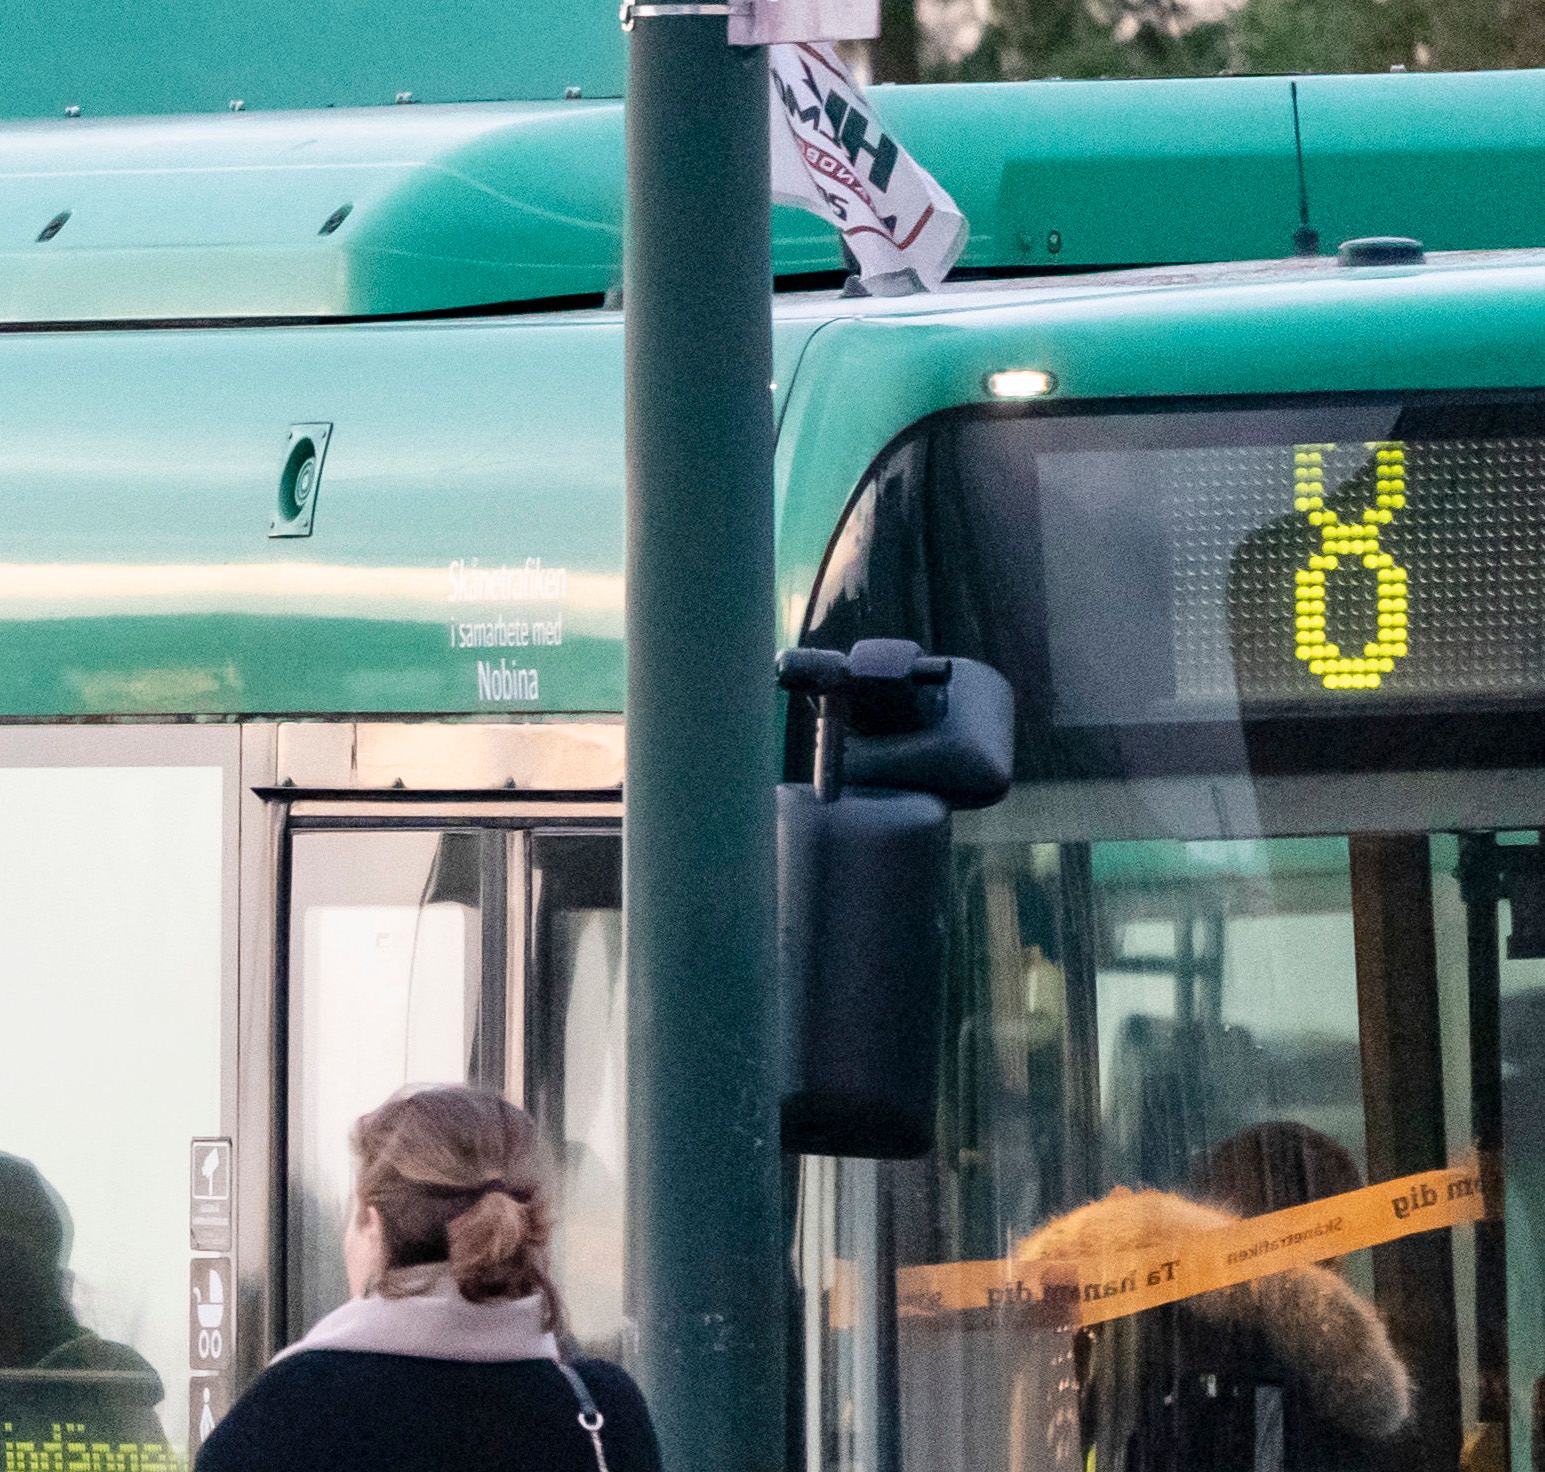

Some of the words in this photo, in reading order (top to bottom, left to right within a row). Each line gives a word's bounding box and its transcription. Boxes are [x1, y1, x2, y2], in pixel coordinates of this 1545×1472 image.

[1293, 441, 1408, 690] 8
[458, 615, 529, 647] samarbete
[532, 612, 563, 645] med
[477, 658, 539, 701] Nobina
